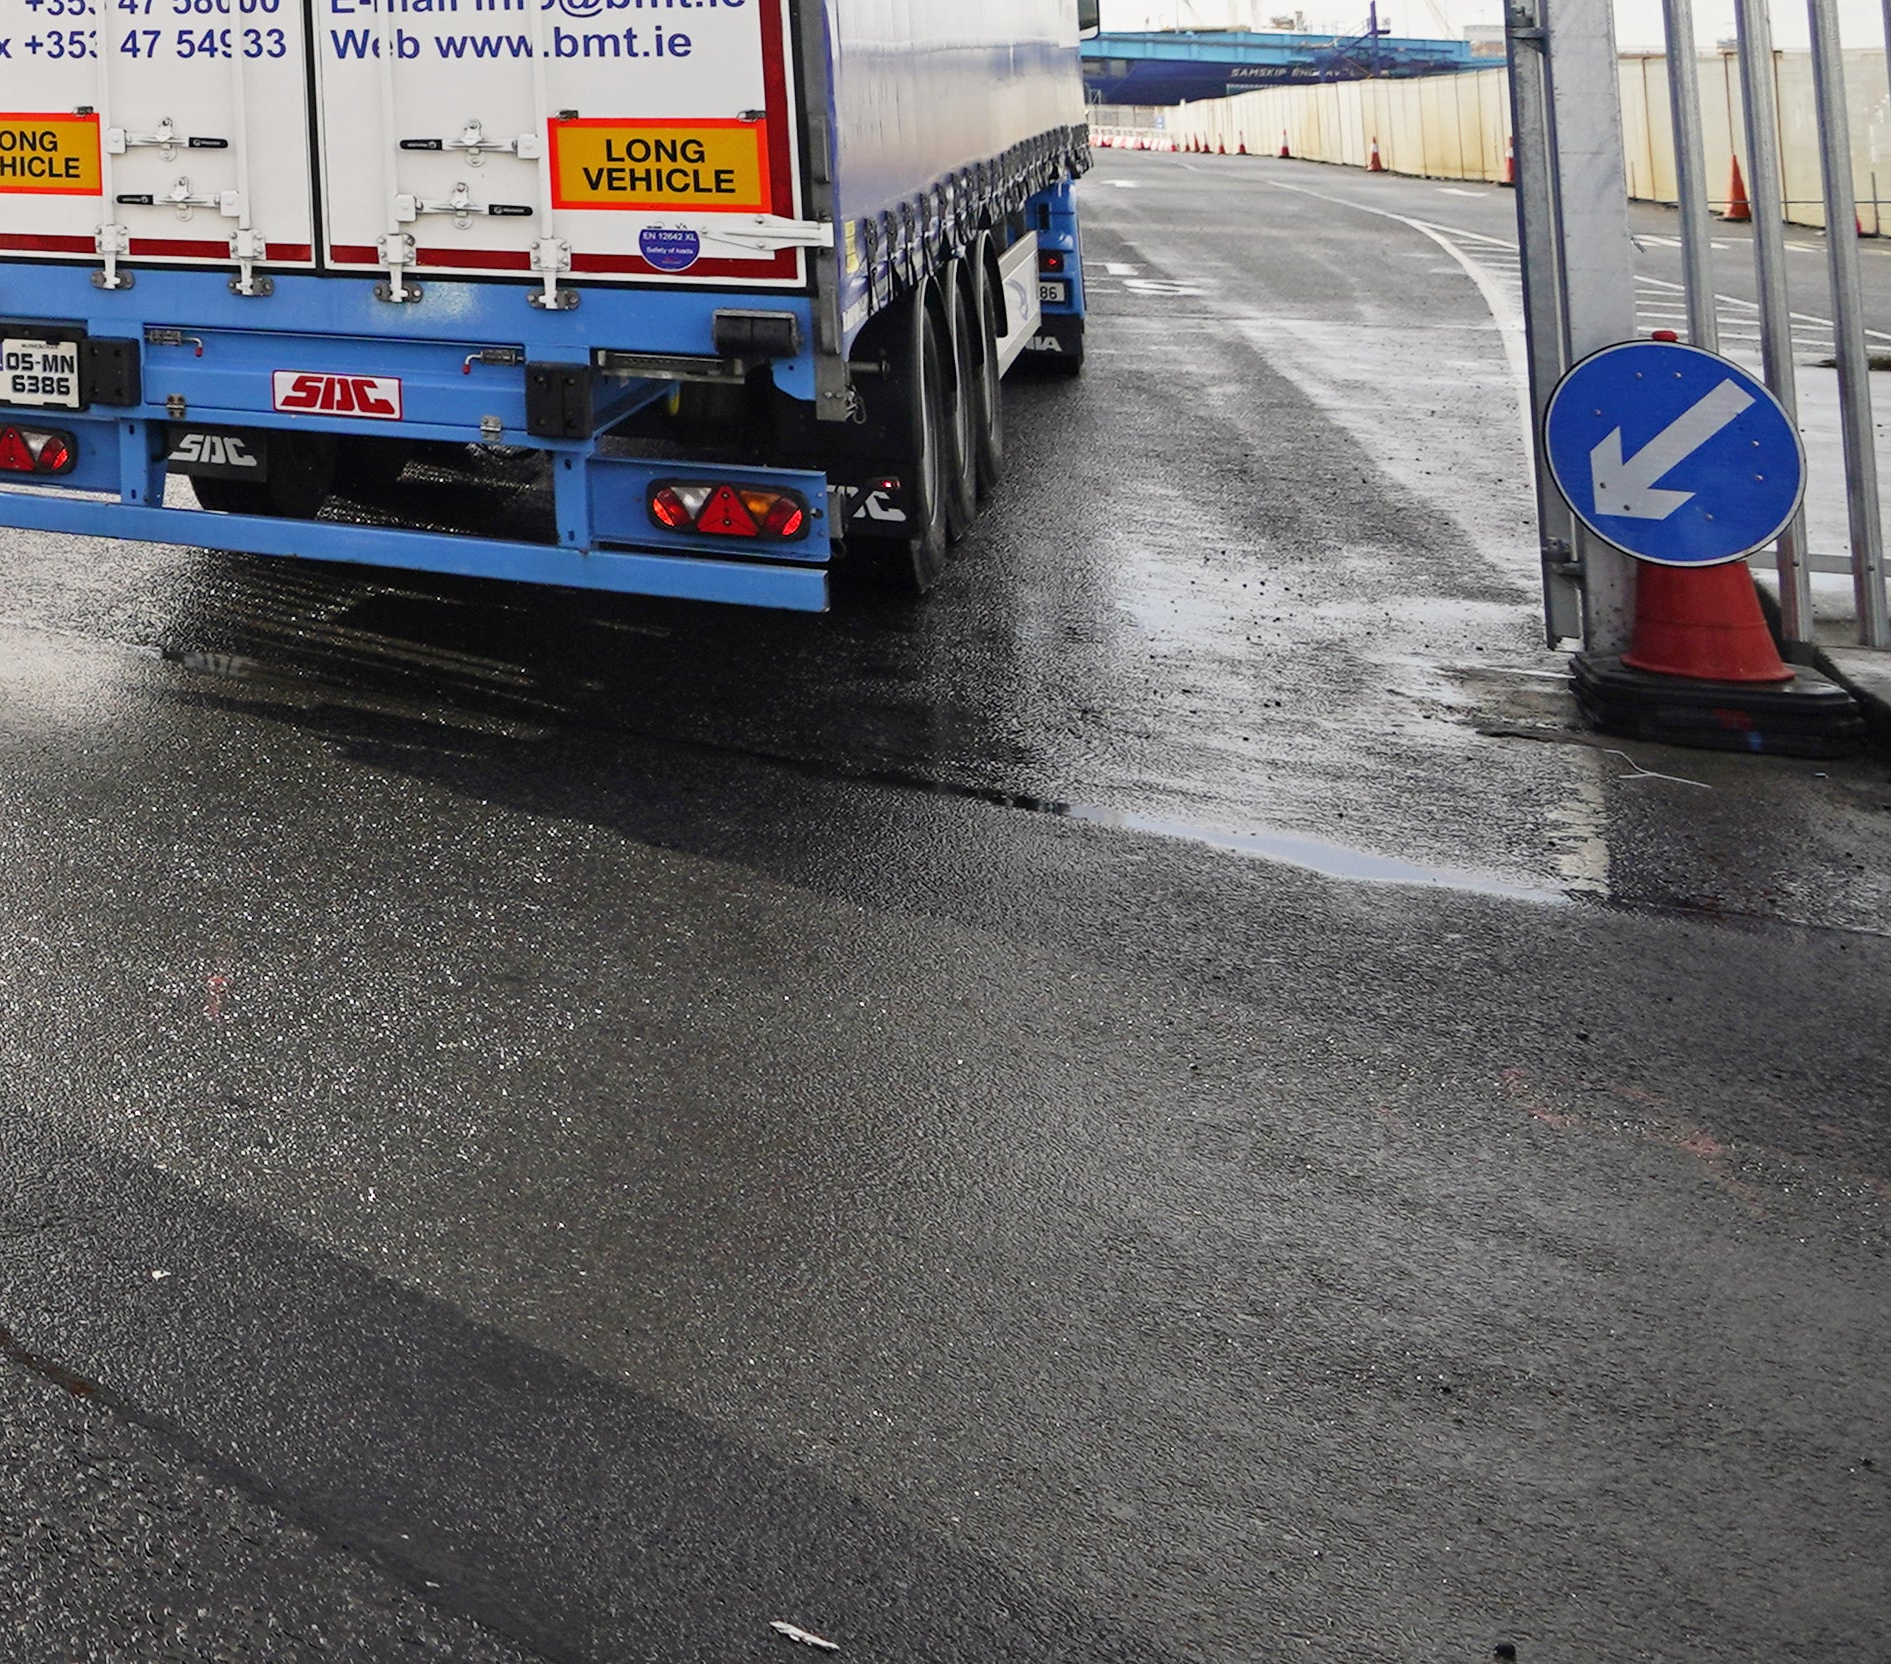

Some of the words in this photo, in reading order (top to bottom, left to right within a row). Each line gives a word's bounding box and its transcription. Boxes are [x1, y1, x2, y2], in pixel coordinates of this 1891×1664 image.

[119, 29, 162, 59] 47
[176, 28, 287, 59] 54933
[435, 25, 693, 59] www.bmt.ie
[1229, 67, 1287, 79] SAMSKIP
[605, 138, 706, 164] LONG
[582, 167, 736, 194] VEHICLE
[5, 351, 75, 374] 05-MN
[11, 374, 71, 396] 6386
[280, 375, 396, 415] SDC
[168, 433, 258, 467] SDC
